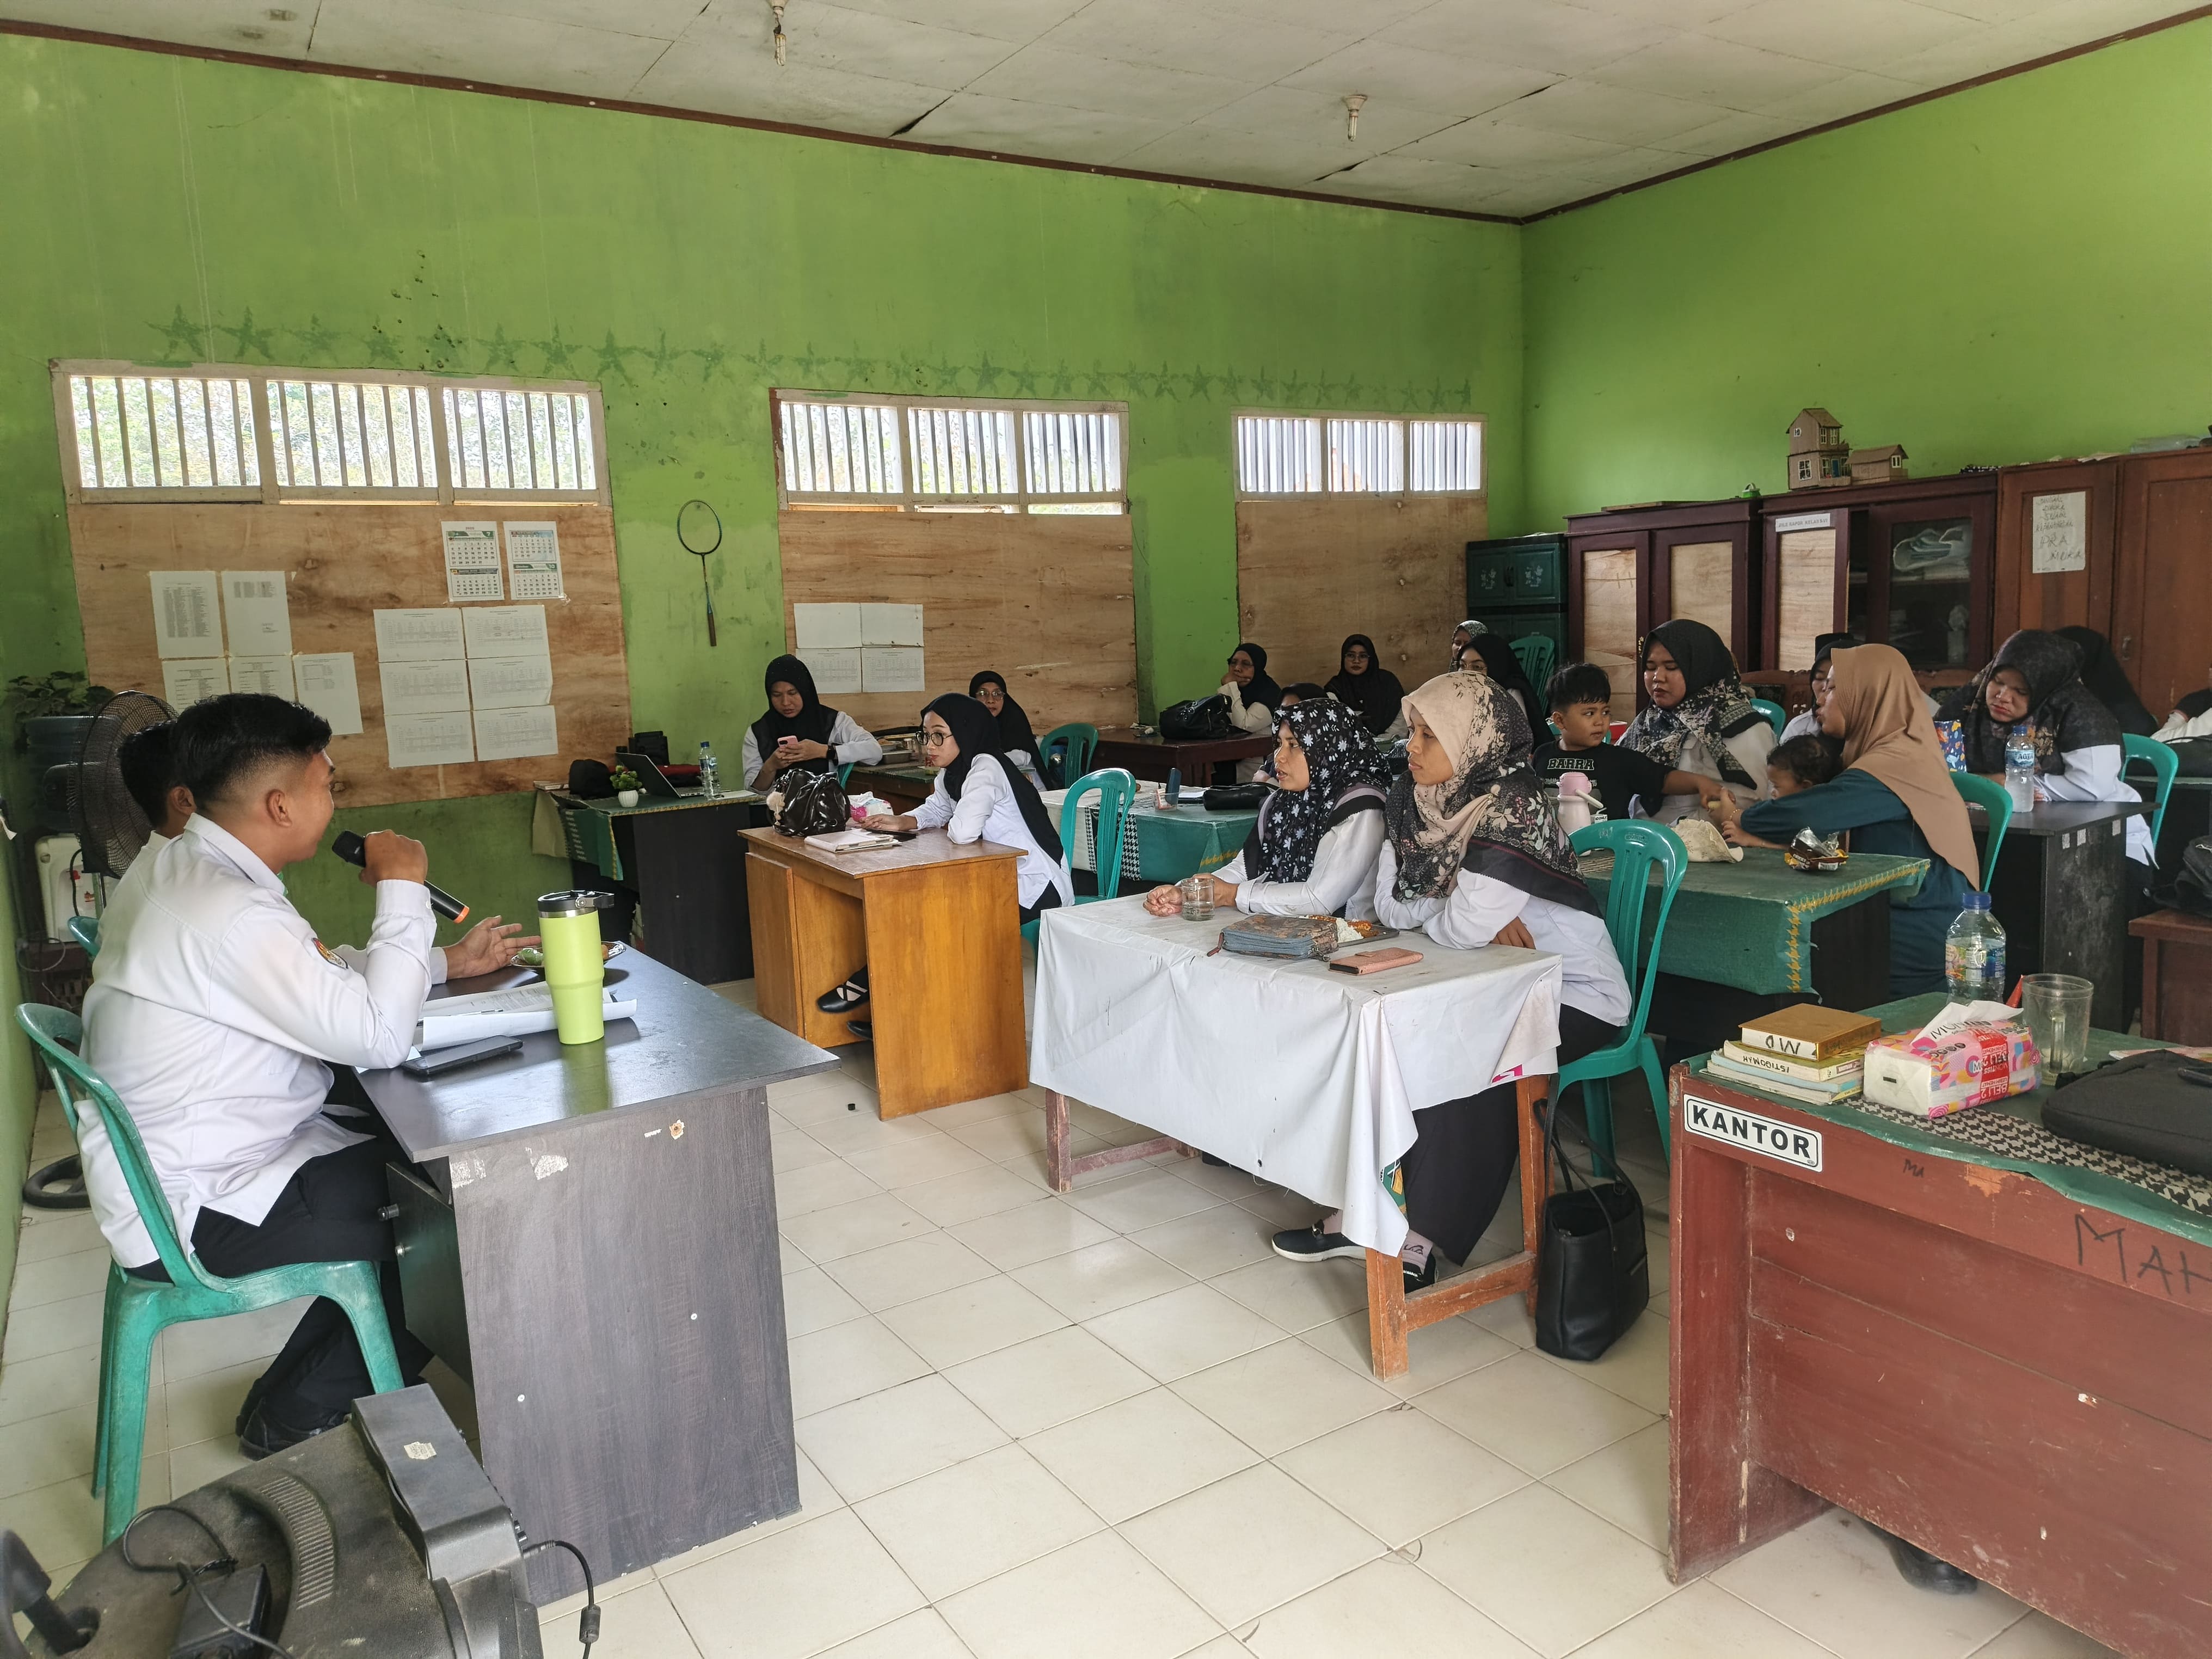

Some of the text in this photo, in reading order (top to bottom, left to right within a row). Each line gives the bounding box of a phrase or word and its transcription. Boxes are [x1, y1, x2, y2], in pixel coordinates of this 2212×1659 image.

[1547, 758, 1594, 770] BARRA
[1981, 1083, 2007, 1099] BELI 2
[1693, 1104, 1810, 1158] KANTOR
